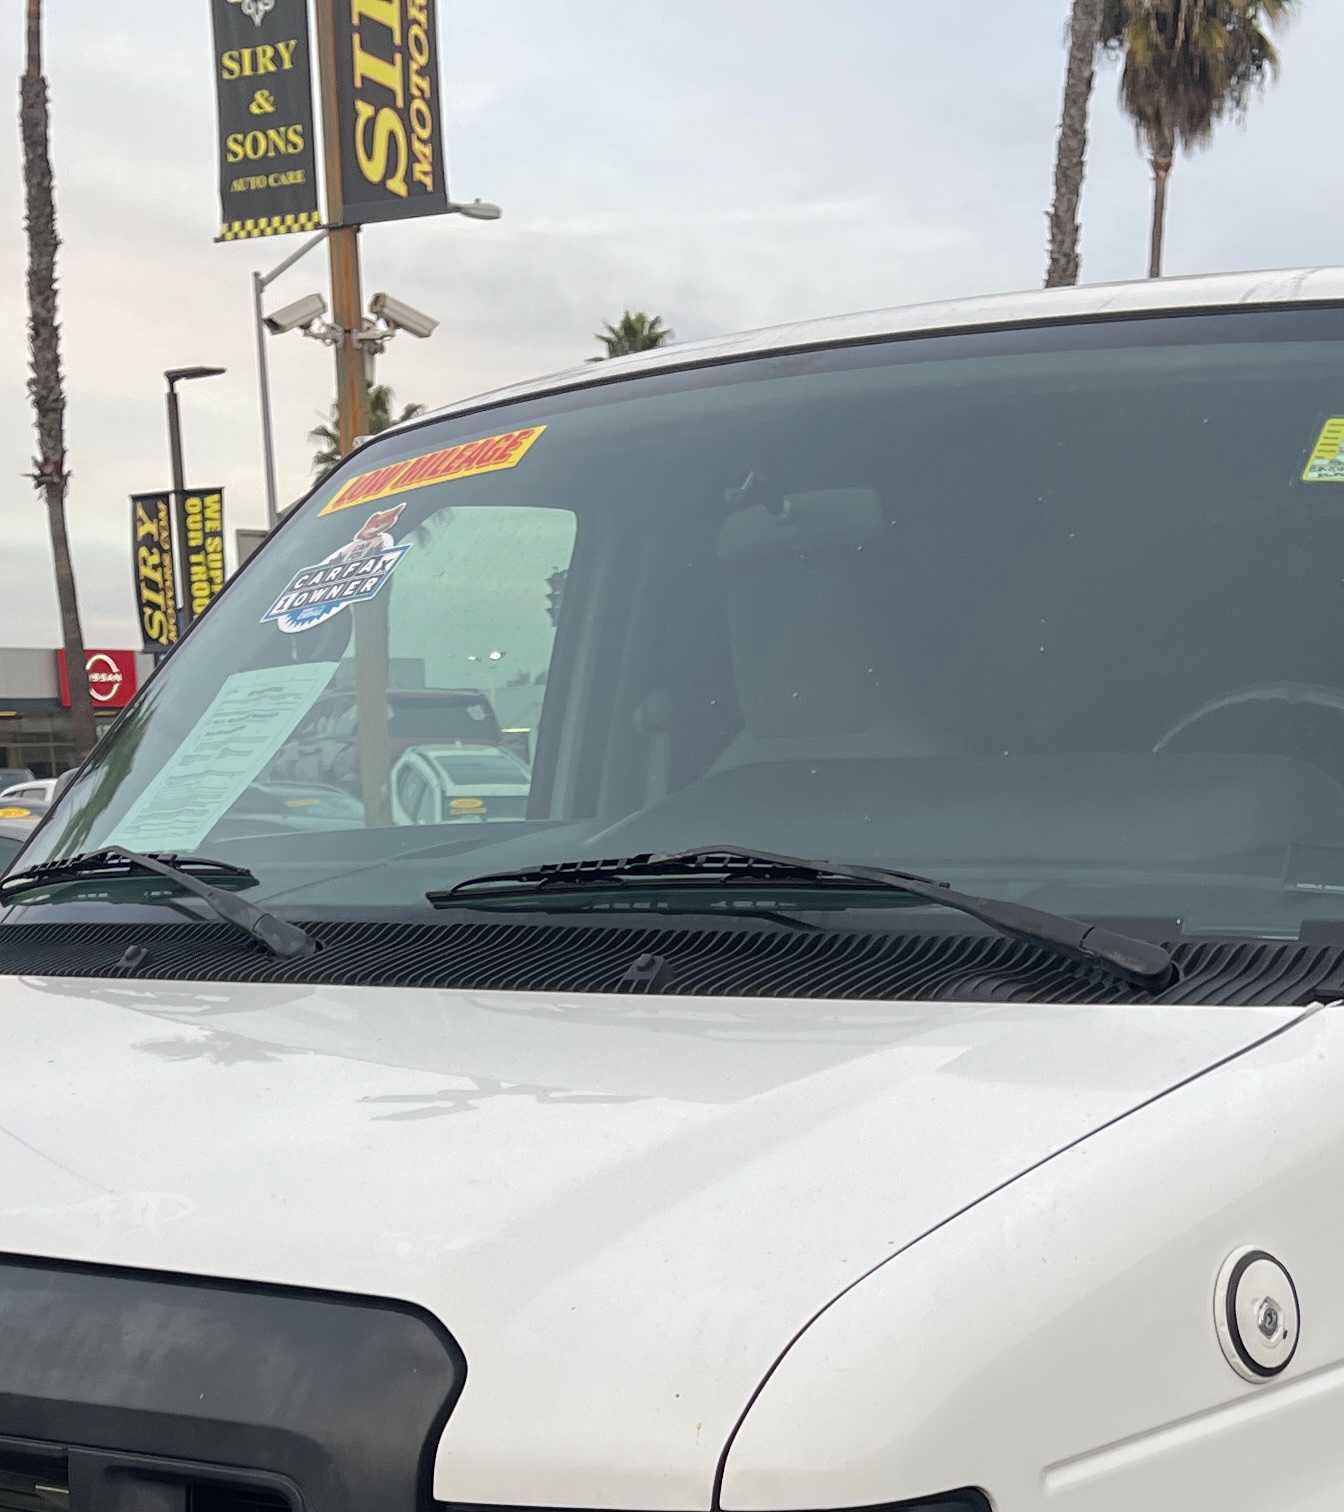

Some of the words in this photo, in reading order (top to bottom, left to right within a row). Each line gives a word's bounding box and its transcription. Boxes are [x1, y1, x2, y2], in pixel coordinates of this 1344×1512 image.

[221, 40, 297, 80] SIRY
[249, 89, 276, 114] &
[226, 125, 304, 162] SONS
[231, 174, 267, 192] AUTO
[269, 170, 305, 187] CARE
[391, 428, 535, 490] MILEAGE
[185, 497, 203, 547] OUR
[204, 494, 221, 531] WE
[136, 502, 169, 645] SIRY
[189, 551, 211, 620] TROO
[294, 577, 379, 606] OWNER
